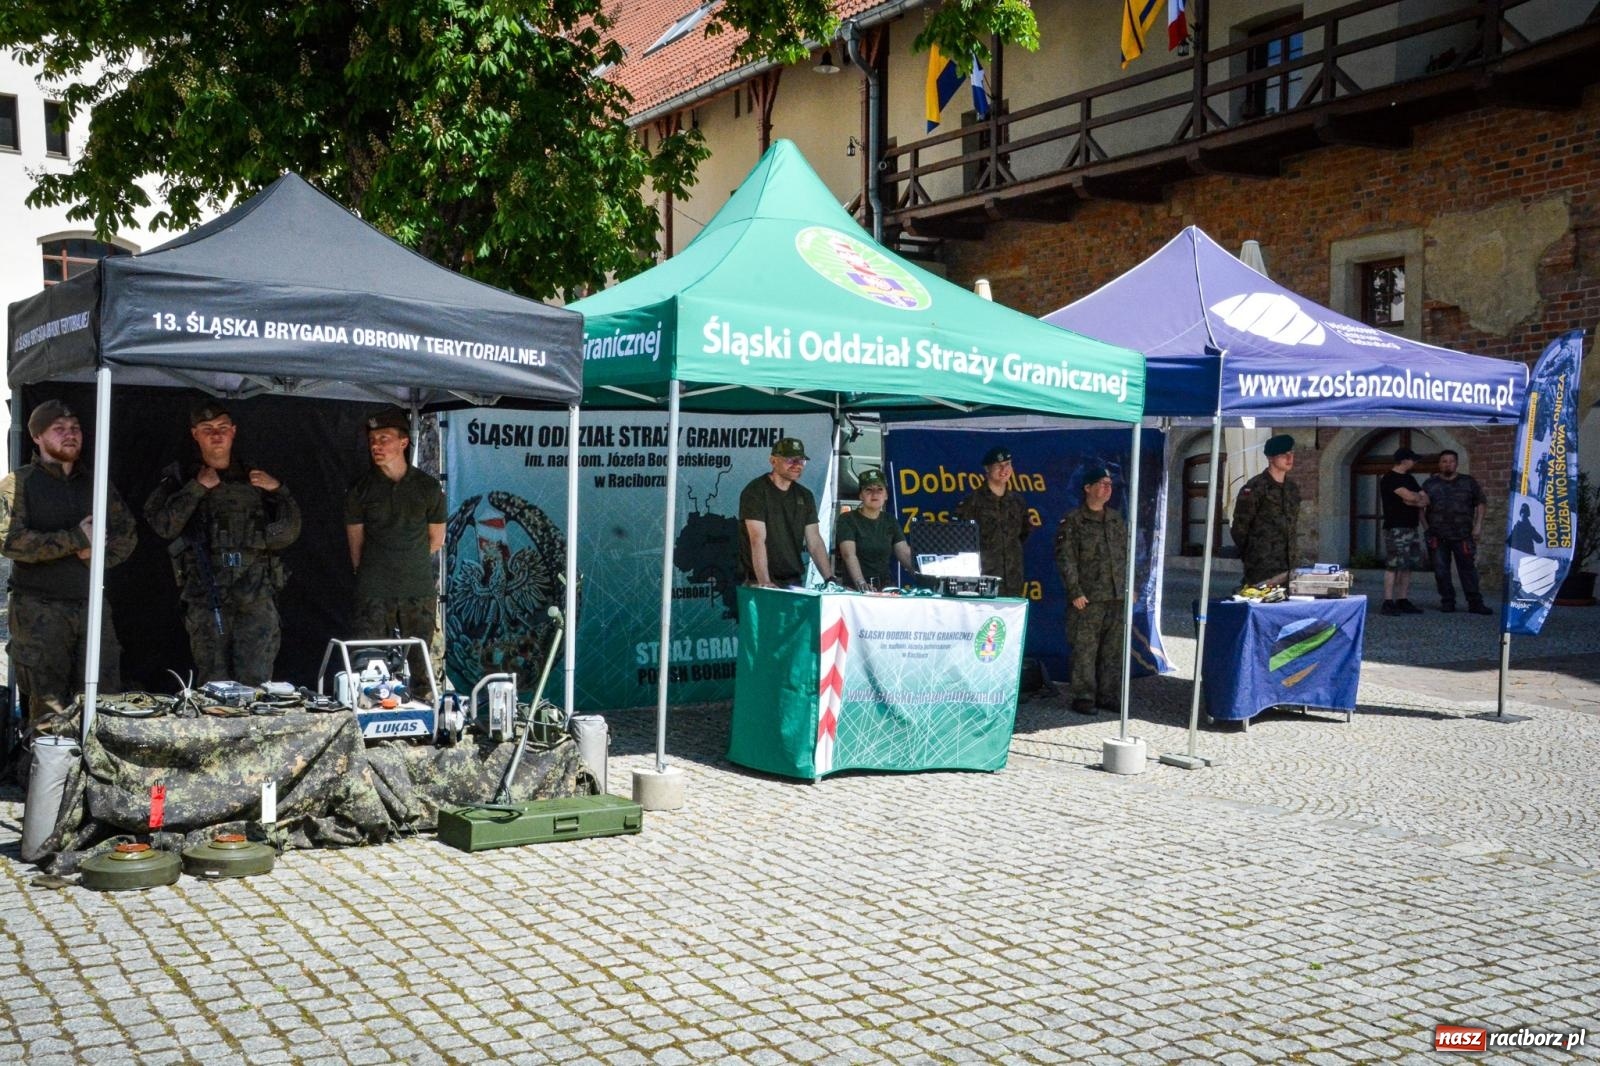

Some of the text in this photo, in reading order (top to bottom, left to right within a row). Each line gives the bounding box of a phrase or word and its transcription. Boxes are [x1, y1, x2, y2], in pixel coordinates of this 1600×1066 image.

[153, 311, 546, 367] 13. ŚLĄSKA BRYGADA OBRONY TERYTORIALNEJ
[703, 315, 1128, 403] Śląski Oddział Straży Granicznej
[1238, 369, 1514, 411] www.zostanzolnierzem.pl
[467, 418, 534, 449] ŚLĄSKI
[524, 452, 545, 467] im.
[607, 452, 645, 467] Józefa
[647, 452, 731, 469] Boceńskiego
[594, 474, 667, 488] w Raciborzu
[900, 465, 1046, 495] Dobrolna
[1556, 424, 1571, 548] SŁUŻBA WOJSKOWA
[1545, 459, 1558, 548] DOBROWOLNA
[635, 636, 693, 665] STAŻ
[375, 722, 418, 734] LUKAS
